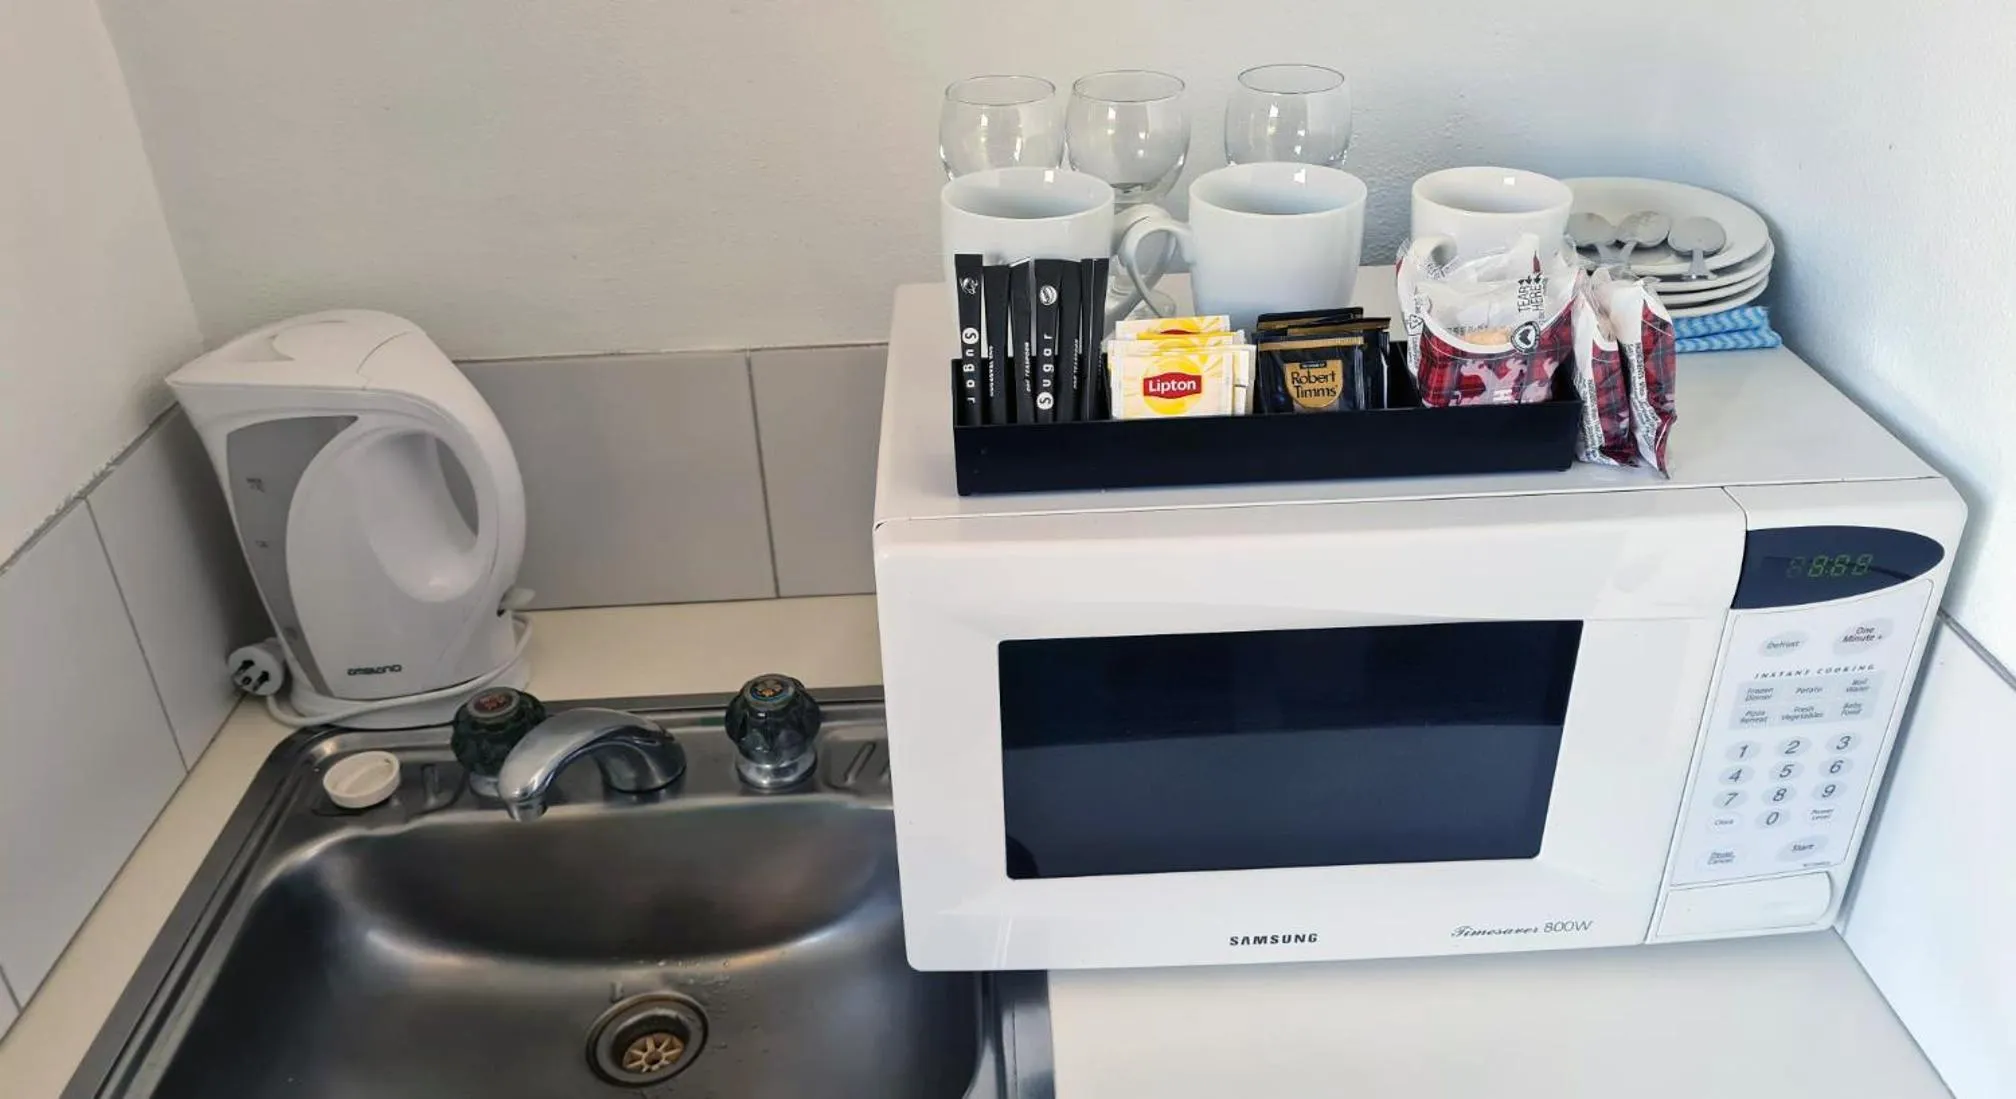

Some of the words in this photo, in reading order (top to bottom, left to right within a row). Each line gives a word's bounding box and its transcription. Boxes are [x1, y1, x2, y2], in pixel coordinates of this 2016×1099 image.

[1517, 285, 1531, 313] TEAR
[1530, 284, 1545, 312] HERE
[962, 328, 979, 404] Sugar
[1036, 334, 1054, 410] Sugar
[1290, 369, 1337, 385] Robert
[1148, 376, 1197, 394] Lipton
[1293, 386, 1337, 399] Timms
[1856, 626, 1875, 634] One
[1842, 634, 1875, 642] Minute
[1753, 669, 1811, 679] INSTANT
[1816, 664, 1876, 675] COOKING
[1784, 740, 1800, 754] 2
[1836, 736, 1851, 750] 3
[1739, 744, 1748, 758] 1
[1780, 764, 1794, 778] 5
[1829, 760, 1844, 774] 6
[1728, 768, 1742, 782] 4
[1773, 788, 1787, 801] 8
[1822, 784, 1836, 798] 9
[1724, 792, 1738, 806] 7
[1766, 811, 1780, 825] 0
[1451, 925, 1539, 938] Timesaver
[1544, 920, 1593, 933] 800W
[1229, 932, 1318, 946] SAMSUNG
